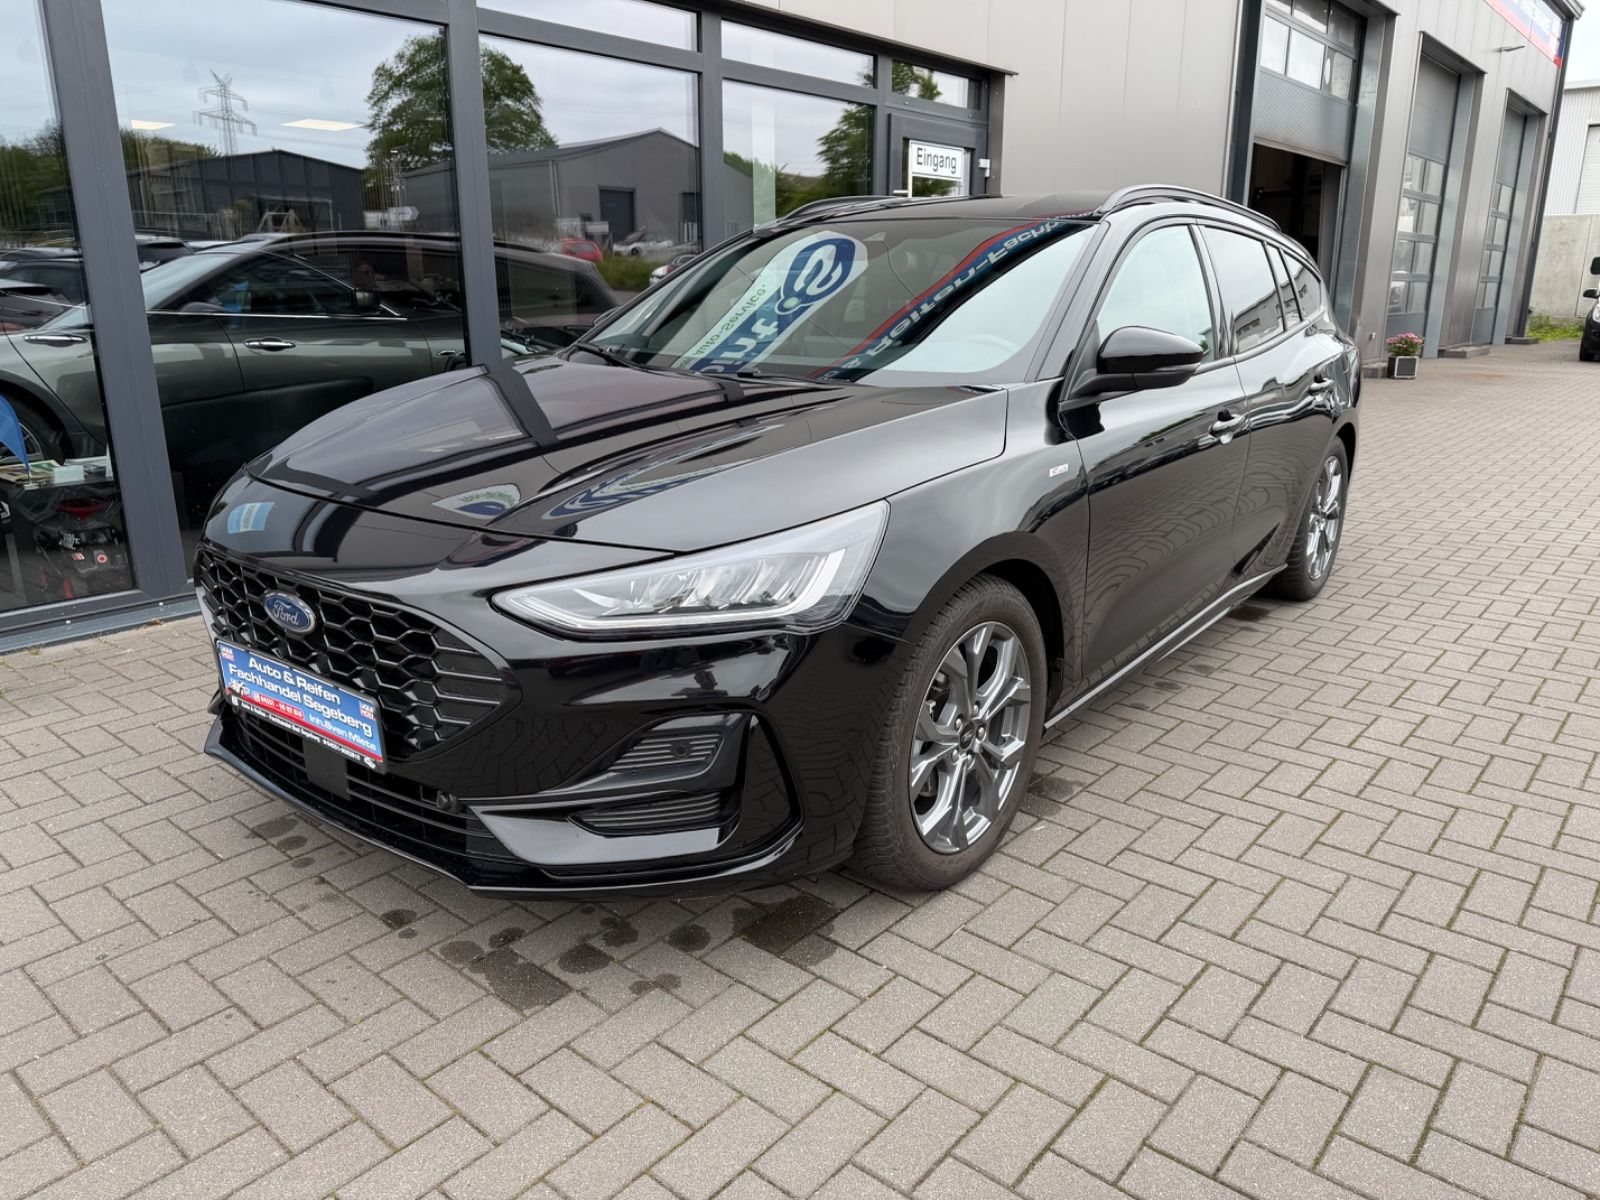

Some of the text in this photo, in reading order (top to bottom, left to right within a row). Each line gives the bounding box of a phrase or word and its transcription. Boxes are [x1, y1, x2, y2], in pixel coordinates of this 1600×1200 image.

[917, 147, 957, 174] Eingang
[273, 600, 300, 625] Ford
[248, 657, 341, 705] Auto & Reifen
[228, 663, 302, 703] Fachhandel
[303, 694, 373, 737] Segeberg
